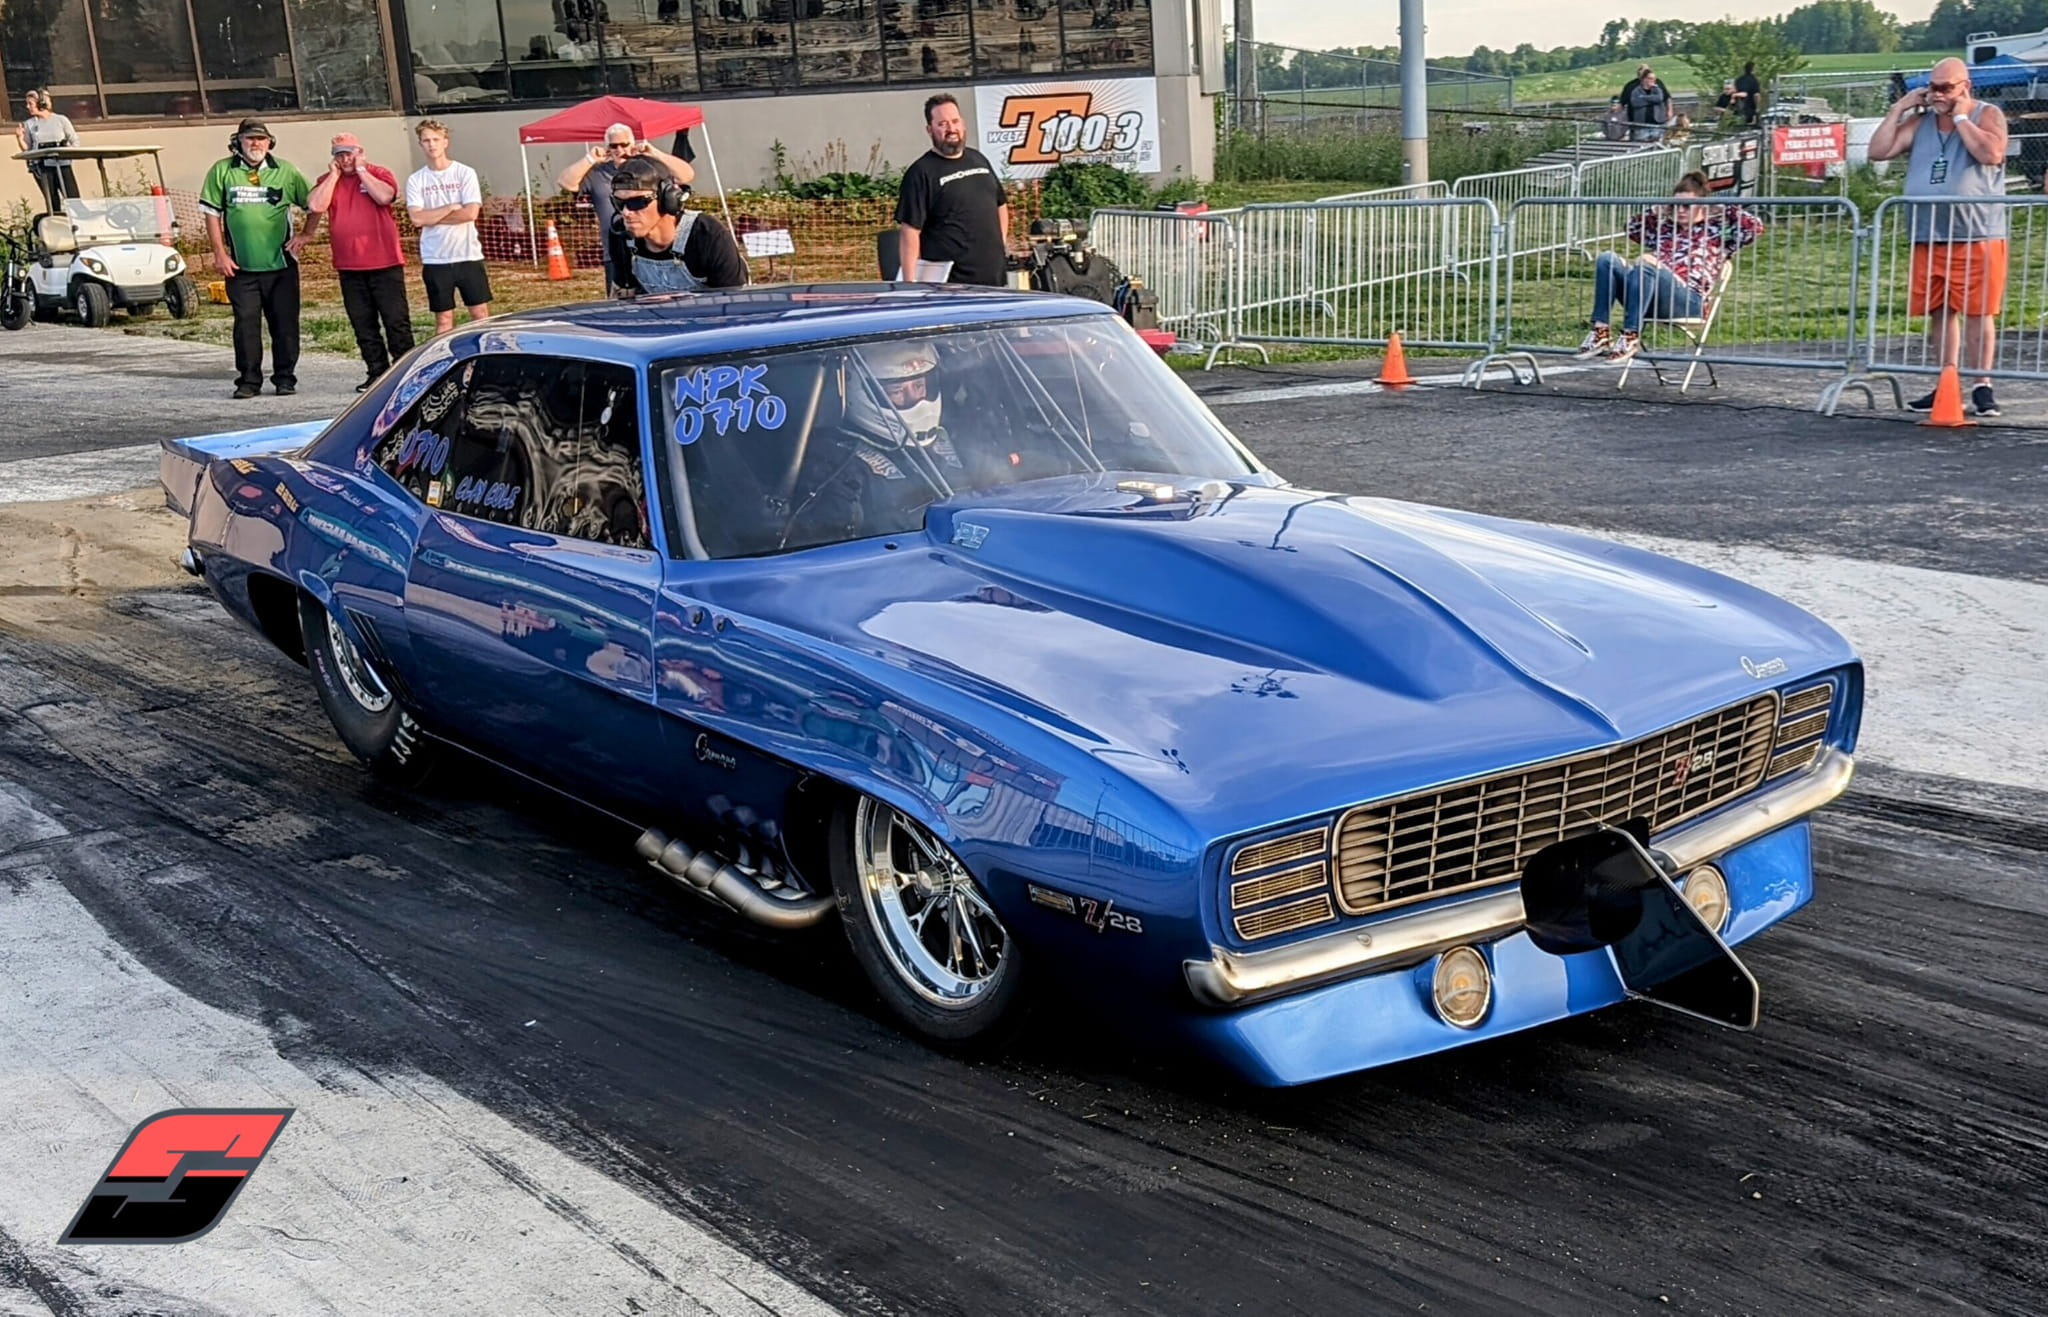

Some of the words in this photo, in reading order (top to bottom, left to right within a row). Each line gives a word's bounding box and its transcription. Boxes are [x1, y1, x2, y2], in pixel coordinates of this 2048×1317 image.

[987, 130, 1022, 143] WCLT
[674, 364, 770, 410] NPK
[673, 395, 787, 445] 0710
